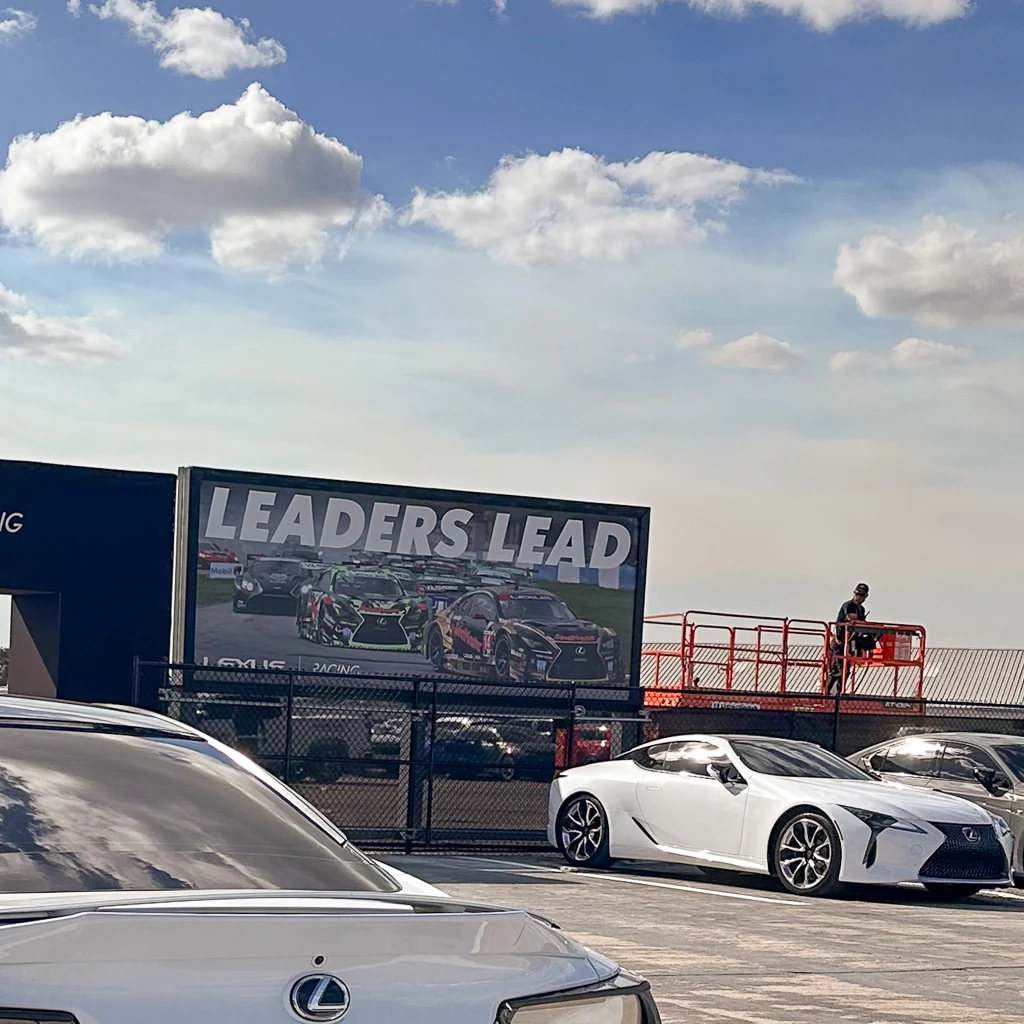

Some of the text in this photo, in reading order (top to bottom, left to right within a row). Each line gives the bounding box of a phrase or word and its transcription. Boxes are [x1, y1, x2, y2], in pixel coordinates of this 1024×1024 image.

[204, 486, 632, 569] LEADERS LEAD
[210, 566, 233, 575] Mobil
[313, 662, 361, 674] RACING
